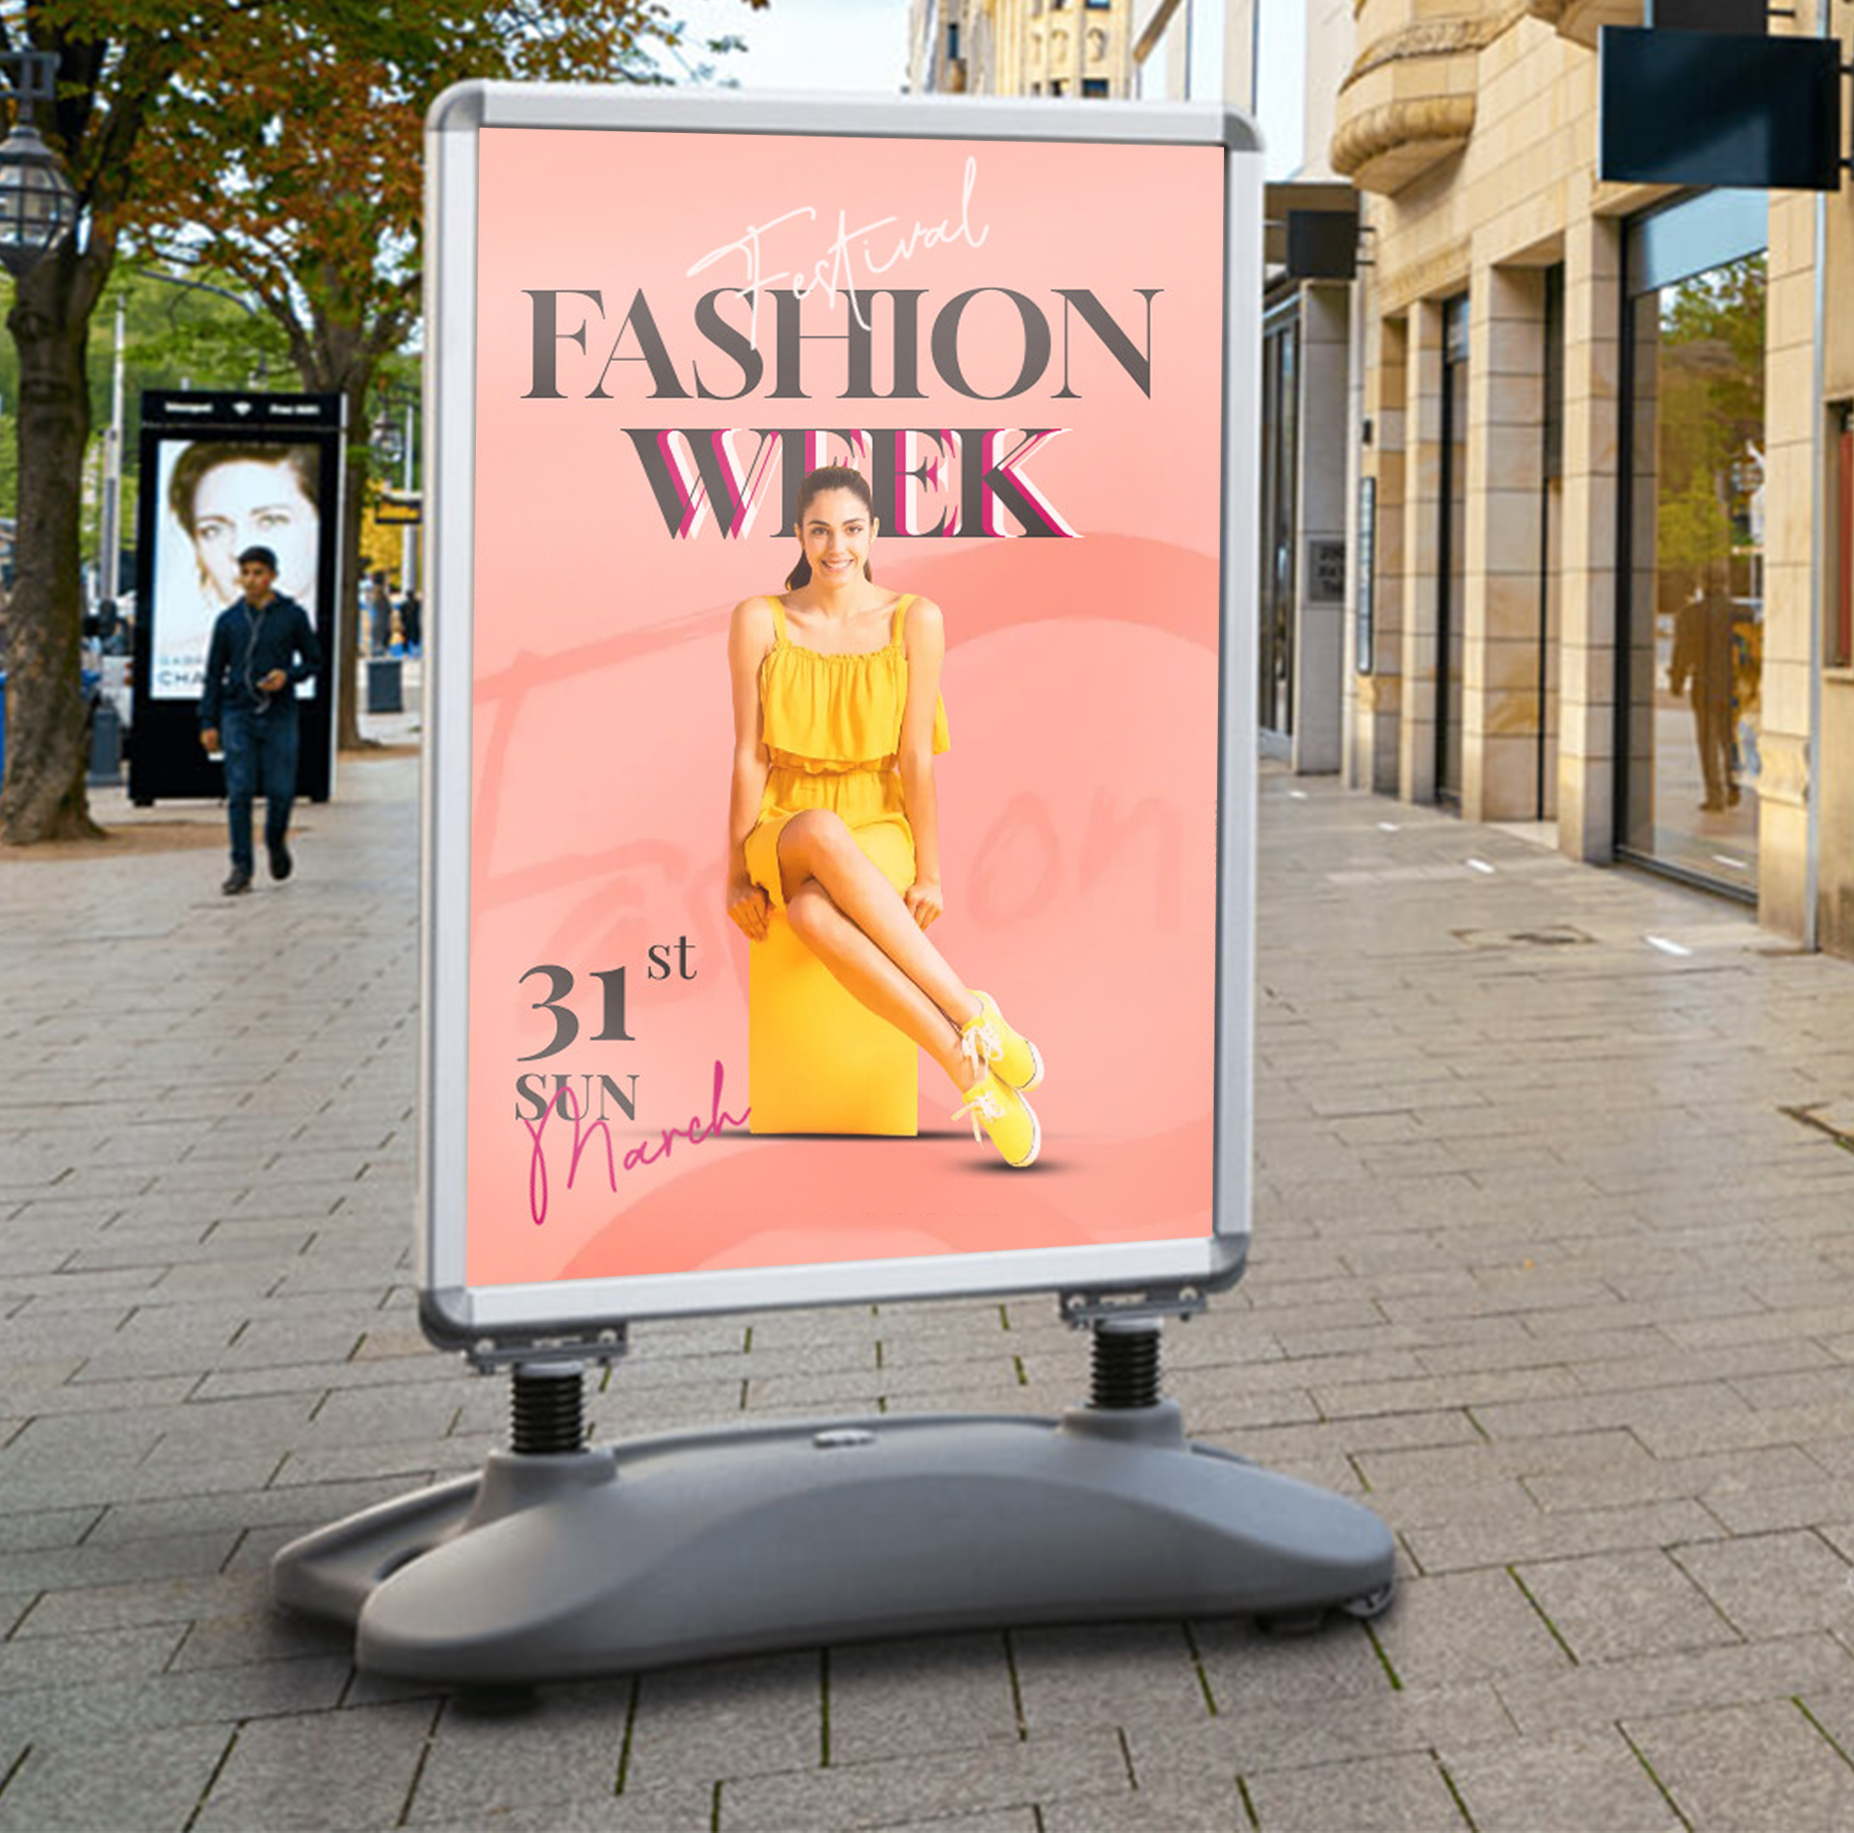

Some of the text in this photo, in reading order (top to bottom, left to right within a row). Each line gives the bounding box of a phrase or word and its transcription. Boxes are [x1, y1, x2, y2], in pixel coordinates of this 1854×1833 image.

[686, 156, 990, 350] Festival
[520, 287, 1165, 401] FASHION
[620, 428, 1084, 540] WEEK
[514, 1073, 640, 1122] SUN
[524, 1060, 752, 1226] March
